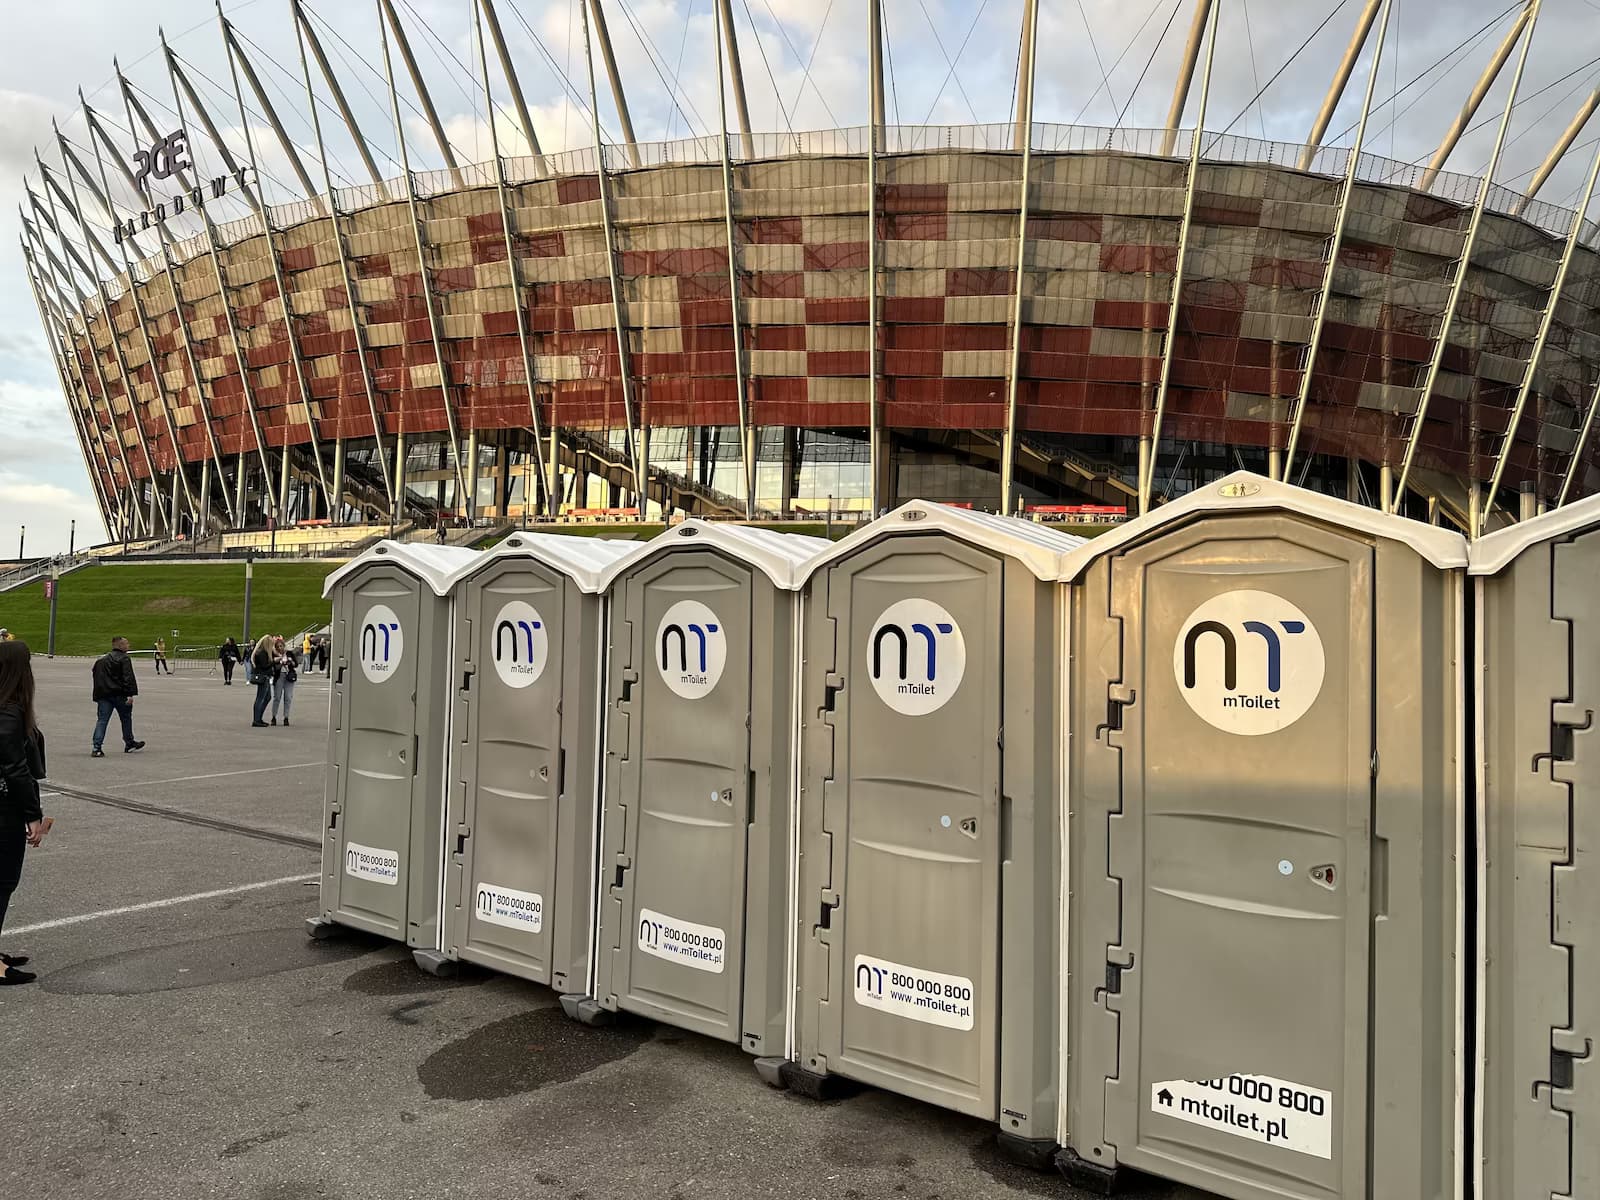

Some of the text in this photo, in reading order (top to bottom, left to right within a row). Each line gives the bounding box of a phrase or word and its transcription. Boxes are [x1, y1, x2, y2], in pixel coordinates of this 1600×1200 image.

[133, 129, 186, 192] PGE
[113, 167, 246, 244] NARODOWY
[371, 664, 389, 672] mToilet
[511, 665, 534, 675] mToilet
[681, 675, 707, 686] mToilet
[897, 684, 936, 697] mToilet
[1223, 695, 1281, 710] mToilet
[497, 895, 540, 912] 800 000 800
[664, 927, 722, 950] 800 000 800
[892, 973, 971, 1001] 800 000 800
[1229, 1075, 1272, 1103] 000
[1278, 1087, 1324, 1116] 800
[1181, 1097, 1288, 1141] mtoilet.pl
